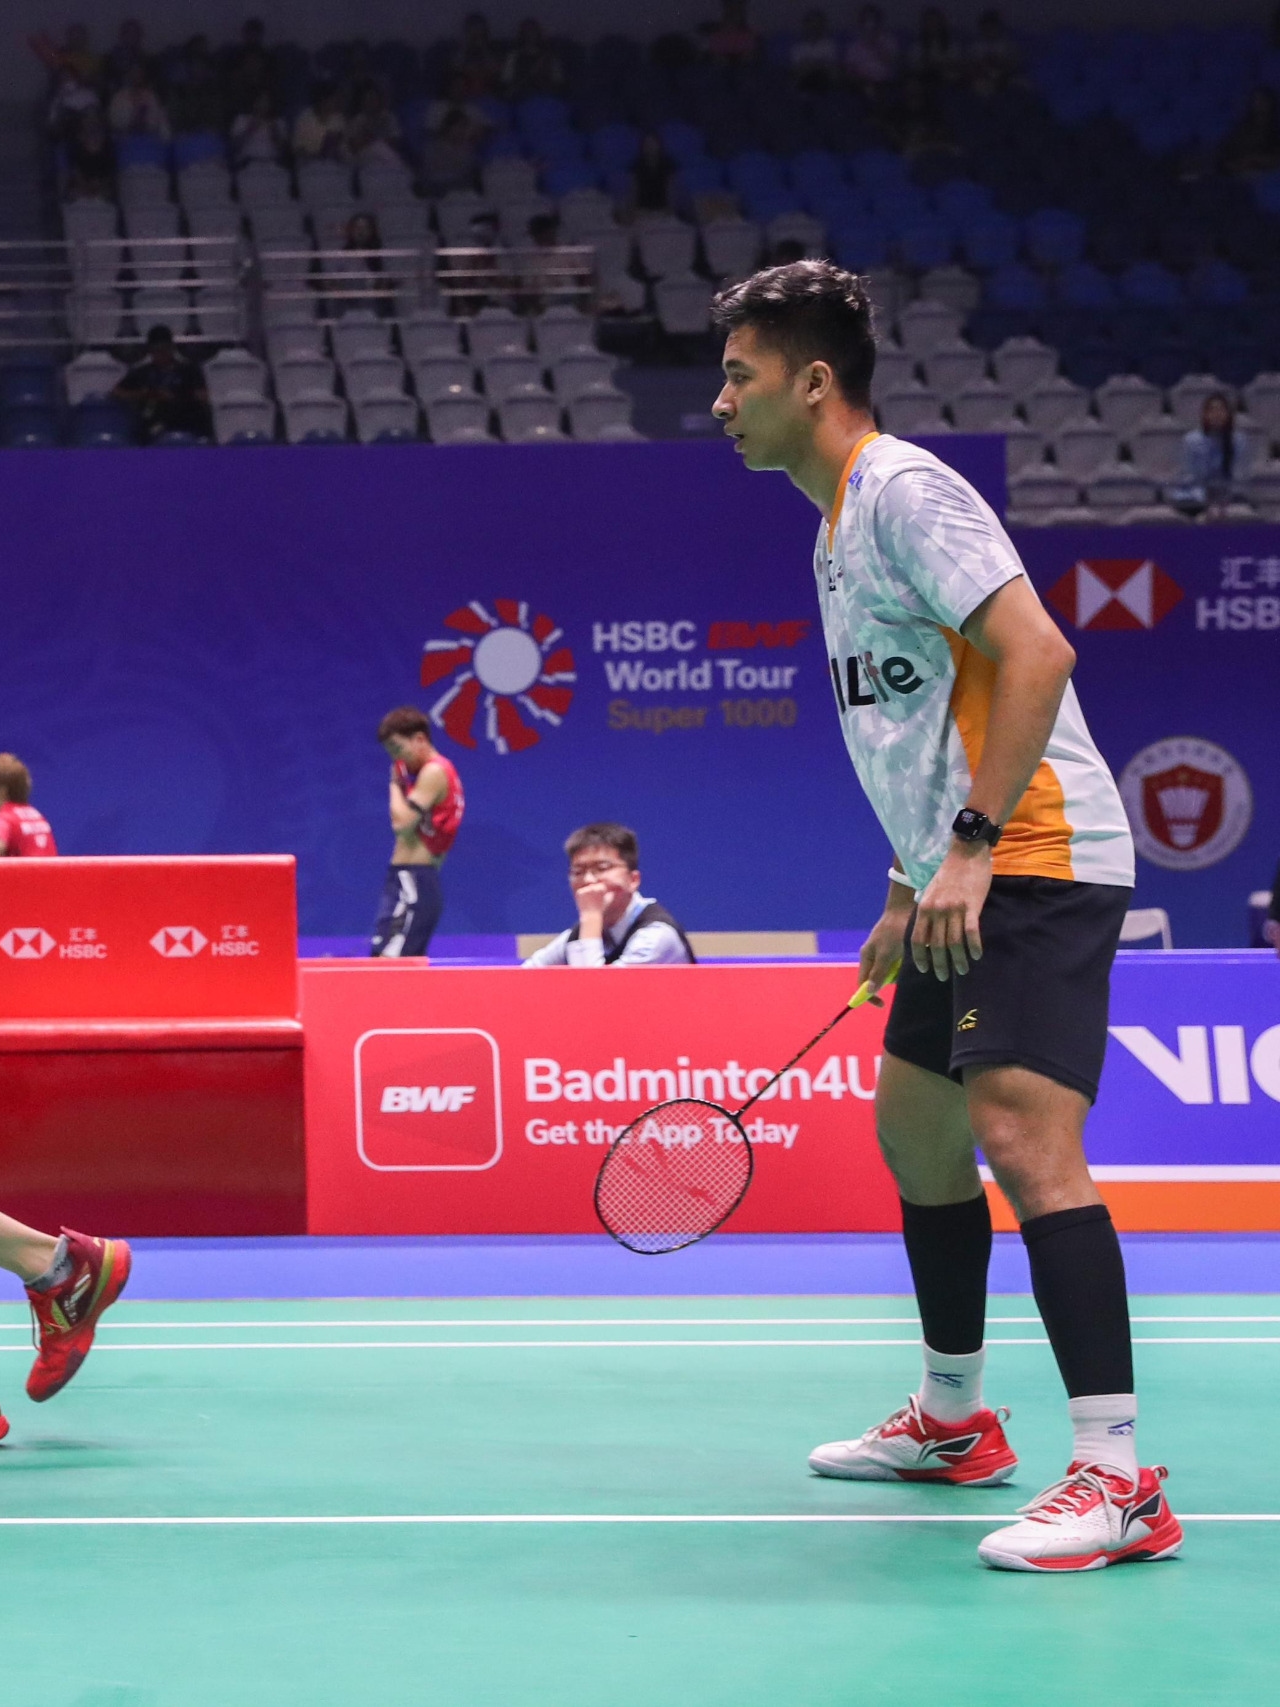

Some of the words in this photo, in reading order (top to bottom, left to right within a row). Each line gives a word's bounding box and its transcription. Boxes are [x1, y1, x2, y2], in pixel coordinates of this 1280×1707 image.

[592, 620, 697, 653] HSBC
[604, 658, 712, 692] World
[716, 658, 798, 690] Tour
[608, 699, 707, 734] Super
[722, 698, 798, 727] 1000
[59, 943, 108, 959] HSBC
[211, 941, 260, 957] HSBC
[524, 1055, 882, 1102] Badminton4U
[381, 1086, 476, 1112] BWF
[525, 1119, 578, 1145] Get
[583, 1118, 631, 1145] the
[638, 1119, 703, 1149] App
[707, 1117, 799, 1149] Today
